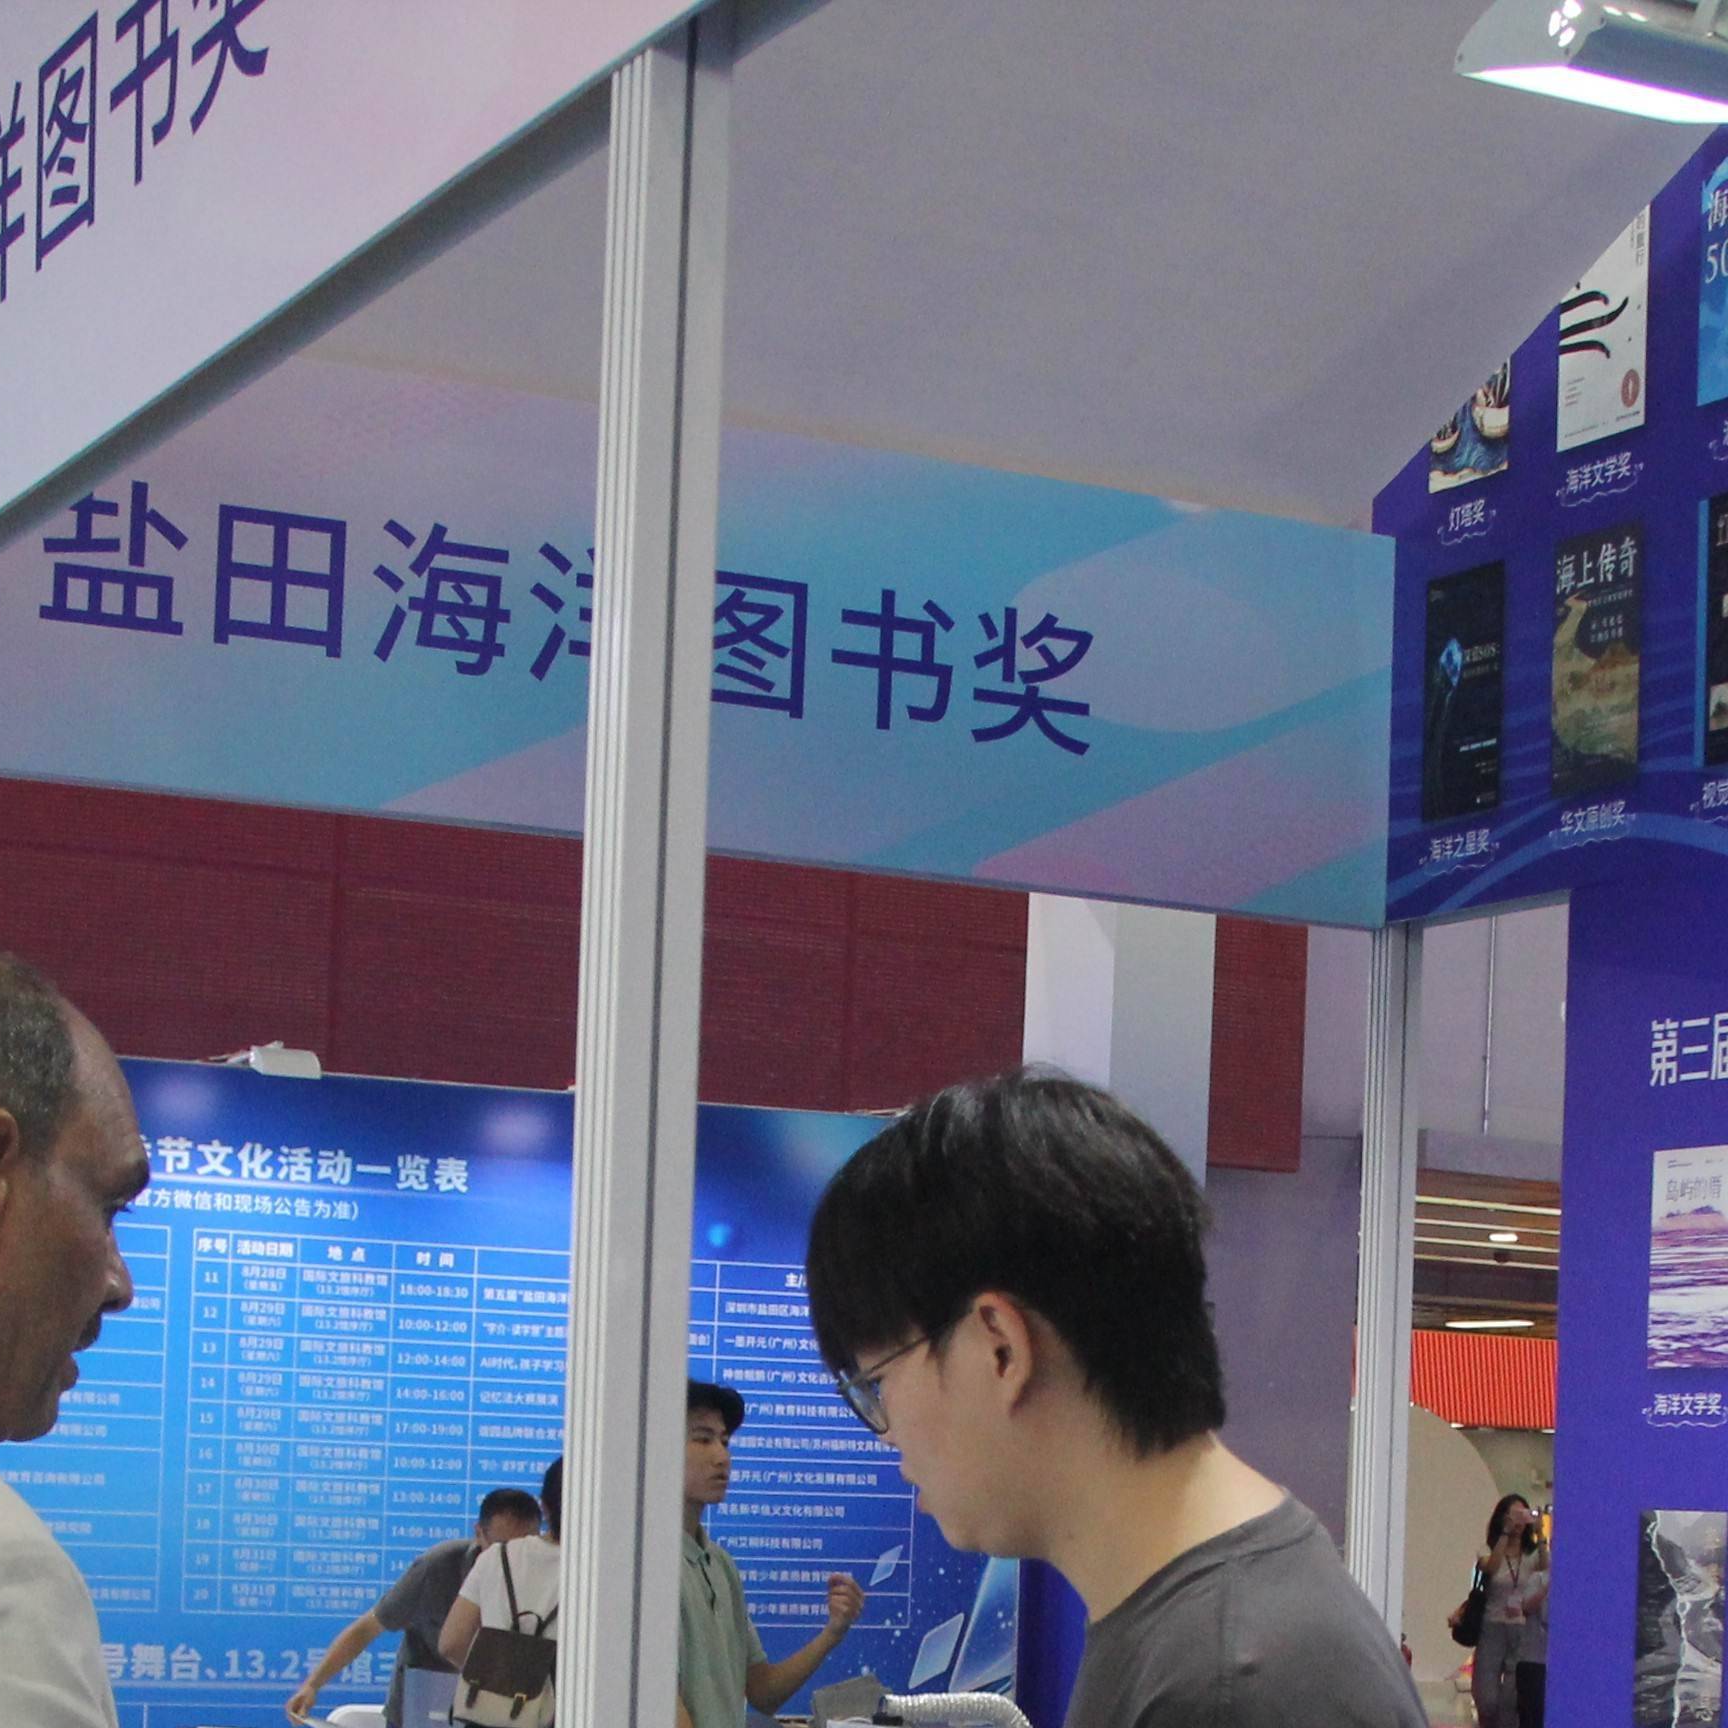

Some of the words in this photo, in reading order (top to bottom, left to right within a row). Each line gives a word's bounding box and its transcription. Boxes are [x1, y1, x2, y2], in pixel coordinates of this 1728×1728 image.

[1565, 452, 1632, 494] 海洋文学奖
[1448, 499, 1486, 532] 灯塔奖
[1556, 536, 1638, 595] 海上传奇
[1560, 801, 1626, 835] 华文原创奖
[1428, 829, 1491, 862] 海洋之星奖
[140, 1134, 469, 1194] 节文化活动一览表
[198, 1237, 228, 1255] 序号
[237, 1239, 294, 1258] 活动日期
[204, 1271, 219, 1284] 11
[203, 1306, 218, 1319] 12
[202, 1341, 217, 1355] 13
[201, 1376, 215, 1390] 14
[1653, 1393, 1722, 1417] 海洋文学奖
[199, 1411, 214, 1424] 15
